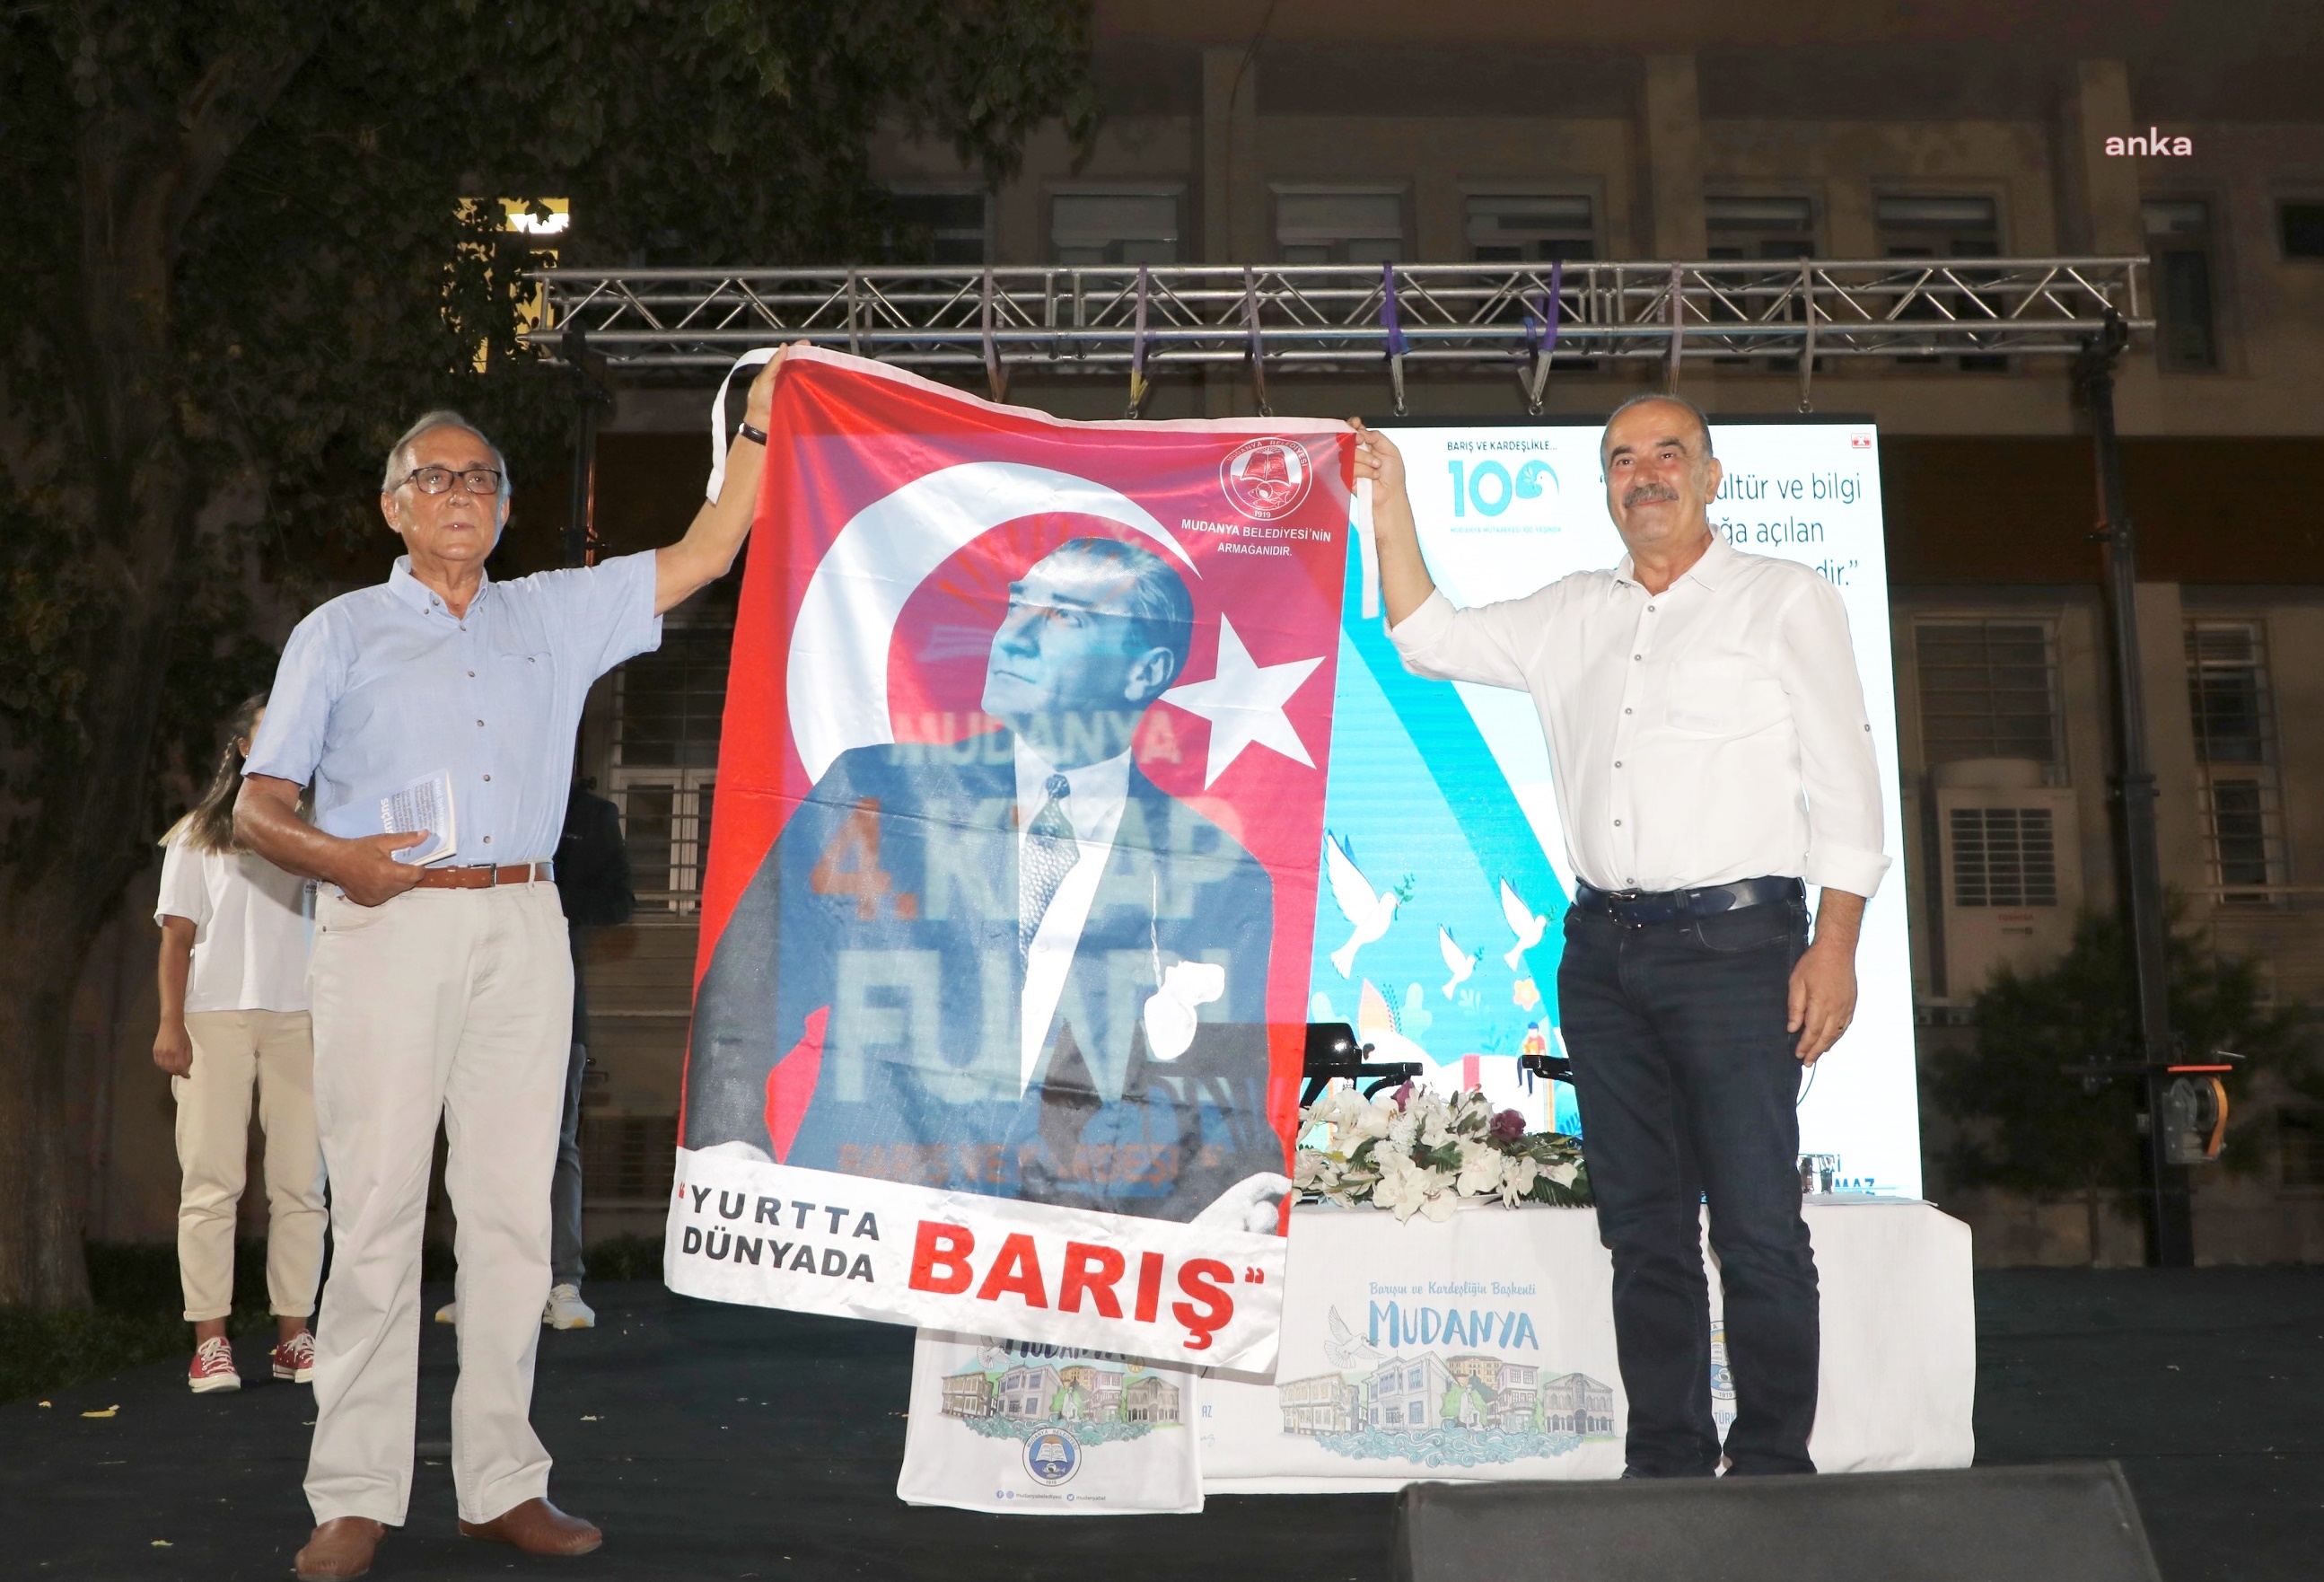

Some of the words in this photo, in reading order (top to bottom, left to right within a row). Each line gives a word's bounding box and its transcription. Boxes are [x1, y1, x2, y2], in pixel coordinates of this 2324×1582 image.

[1447, 441, 1474, 453] BARIŞ
[1477, 440, 1490, 450] VE
[1777, 479, 1803, 499] ve
[1812, 472, 1861, 504] bilgi
[1254, 510, 1271, 518] 1919
[1181, 518, 1240, 535] MUDANYA
[1757, 515, 1824, 547] açılan
[1217, 541, 1293, 557] ARMAĞANIDIR.
[682, 1225, 874, 1283] DÜNYADA
[1369, 1281, 1407, 1296] Barışın
[1412, 1285, 1423, 1295] ve
[1428, 1281, 1487, 1297] Kardeşliğin
[1491, 1282, 1537, 1297] Başkenti
[1369, 1299, 1539, 1350] MUDANYA
